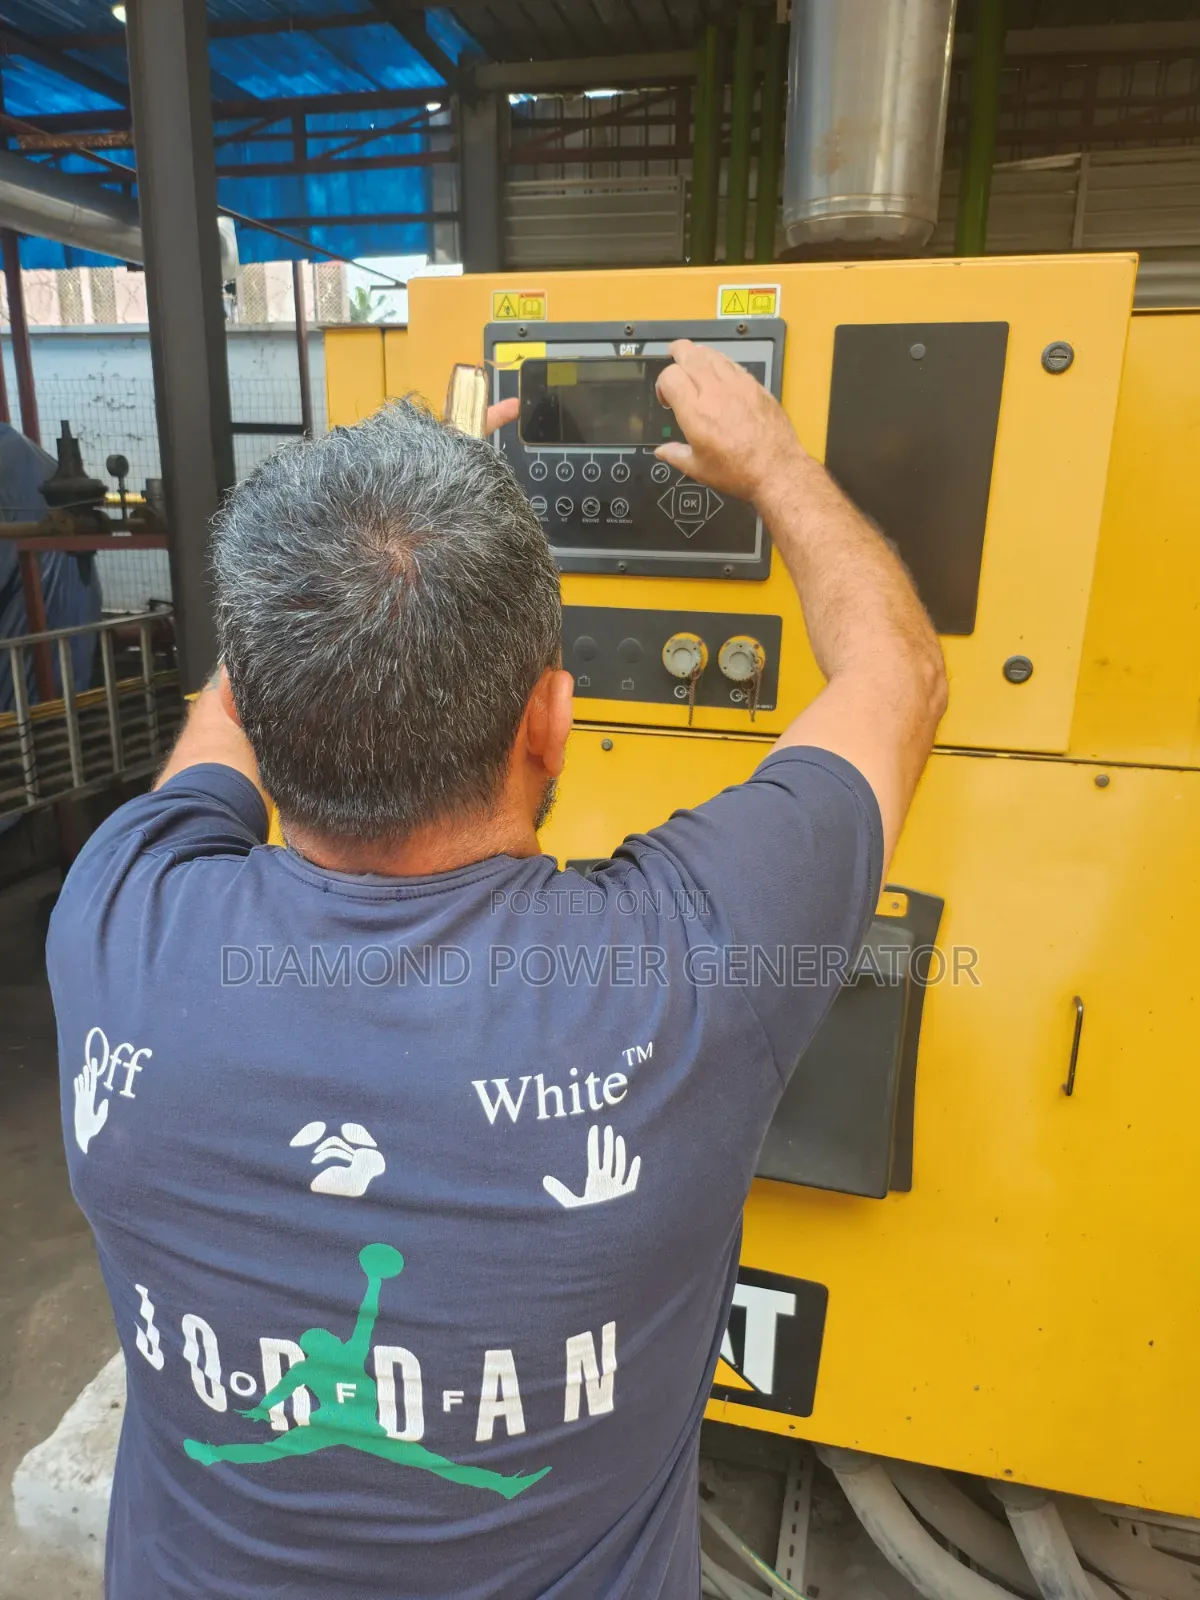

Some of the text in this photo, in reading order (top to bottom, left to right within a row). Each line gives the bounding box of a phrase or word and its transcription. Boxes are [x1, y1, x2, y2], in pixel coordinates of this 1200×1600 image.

[620, 343, 636, 356] CAT
[683, 499, 698, 508] OK
[85, 1026, 153, 1100] Off
[471, 1066, 629, 1125] White
